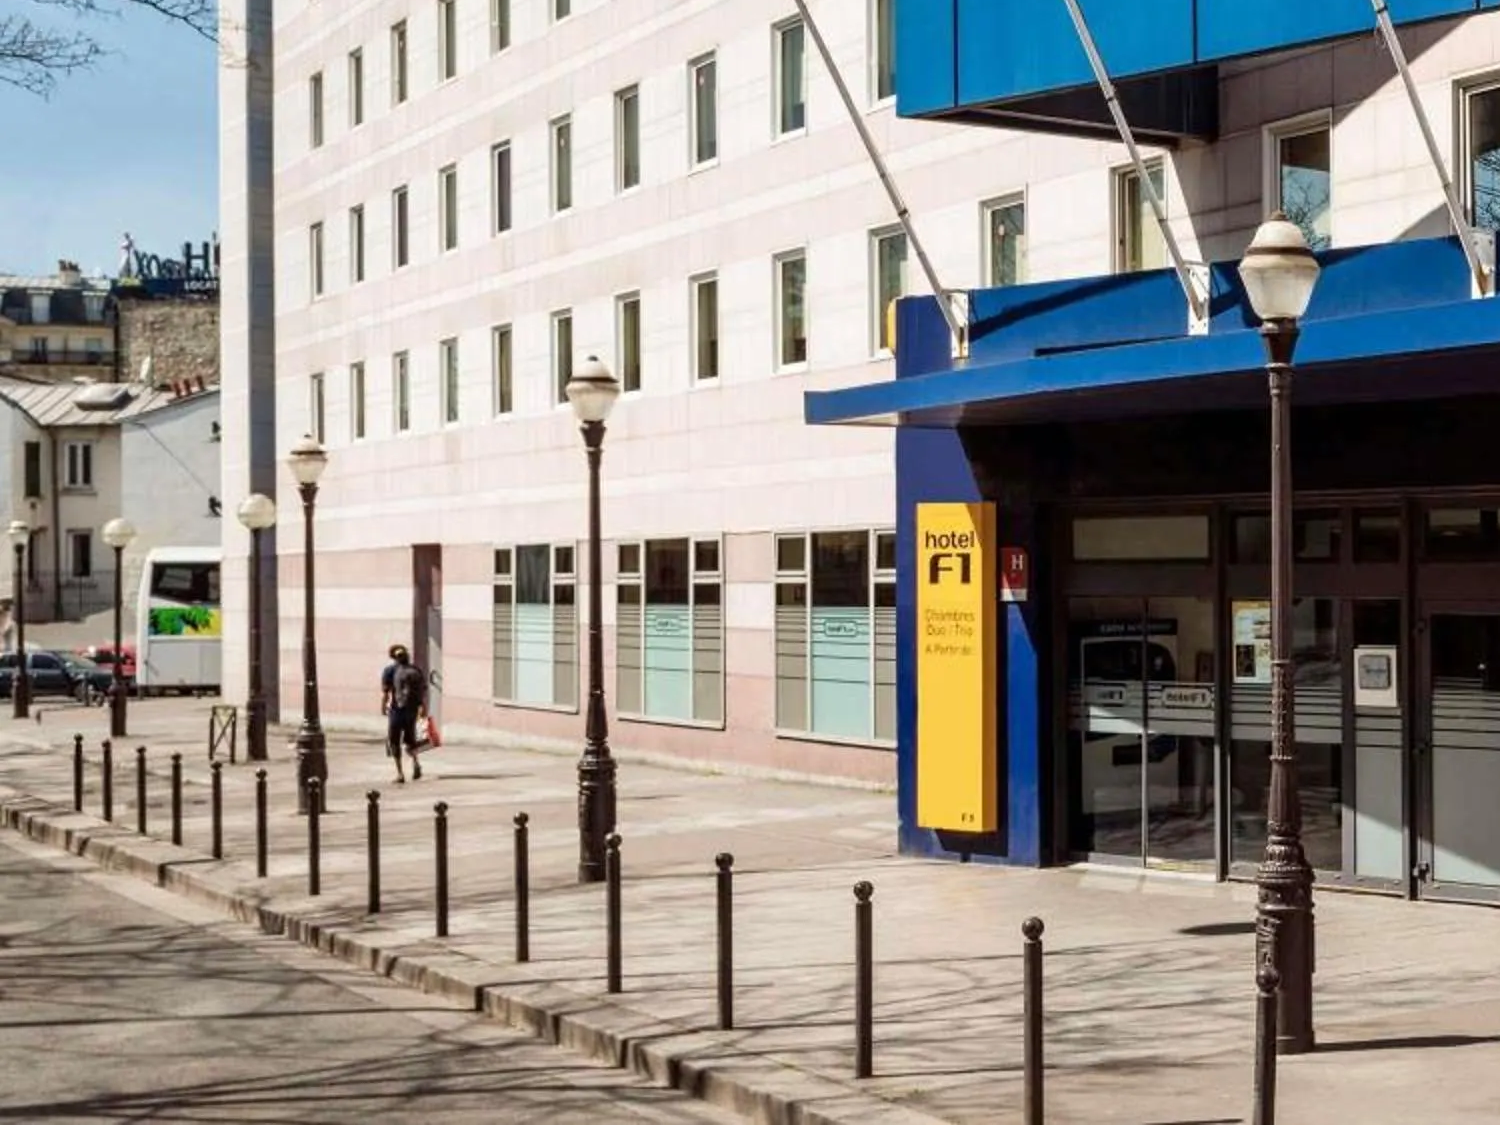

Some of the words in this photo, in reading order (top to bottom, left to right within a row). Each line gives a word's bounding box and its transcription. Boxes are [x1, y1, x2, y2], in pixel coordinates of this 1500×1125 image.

[925, 530, 975, 549] hotel
[929, 552, 971, 584] F1
[1011, 554, 1023, 570] H
